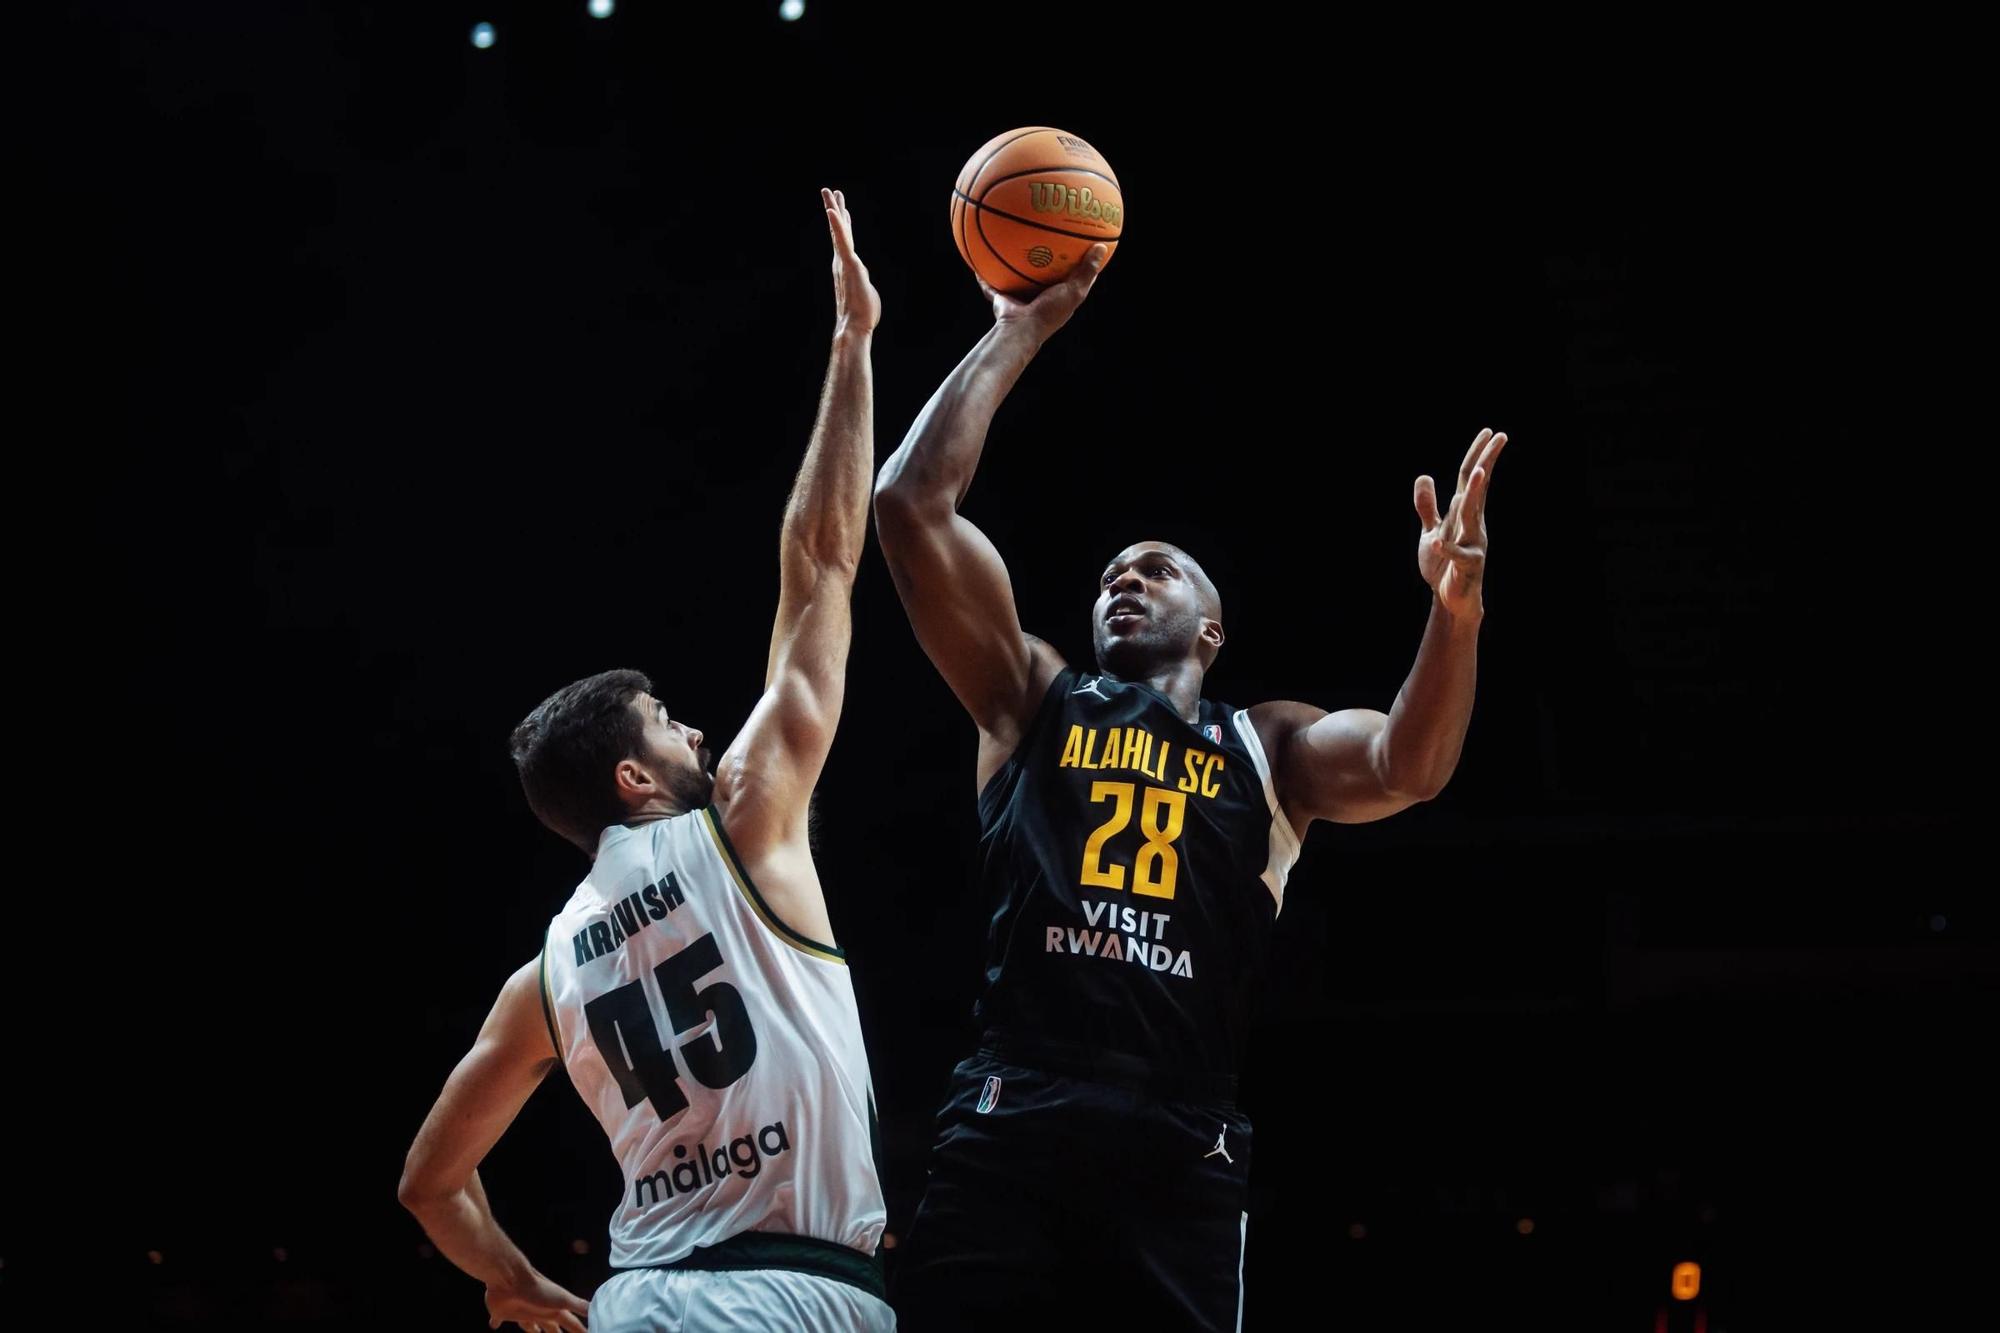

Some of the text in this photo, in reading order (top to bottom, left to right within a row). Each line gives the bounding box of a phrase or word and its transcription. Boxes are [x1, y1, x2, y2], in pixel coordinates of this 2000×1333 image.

[1029, 182, 1121, 228] Wilson
[1059, 724, 1225, 799] ALAHLI SC
[1080, 781, 1187, 900] 28
[572, 870, 686, 968] KRAVISH
[1045, 926, 1194, 979] RWANDA
[1081, 900, 1170, 940] VISIT
[584, 931, 758, 1123] 45
